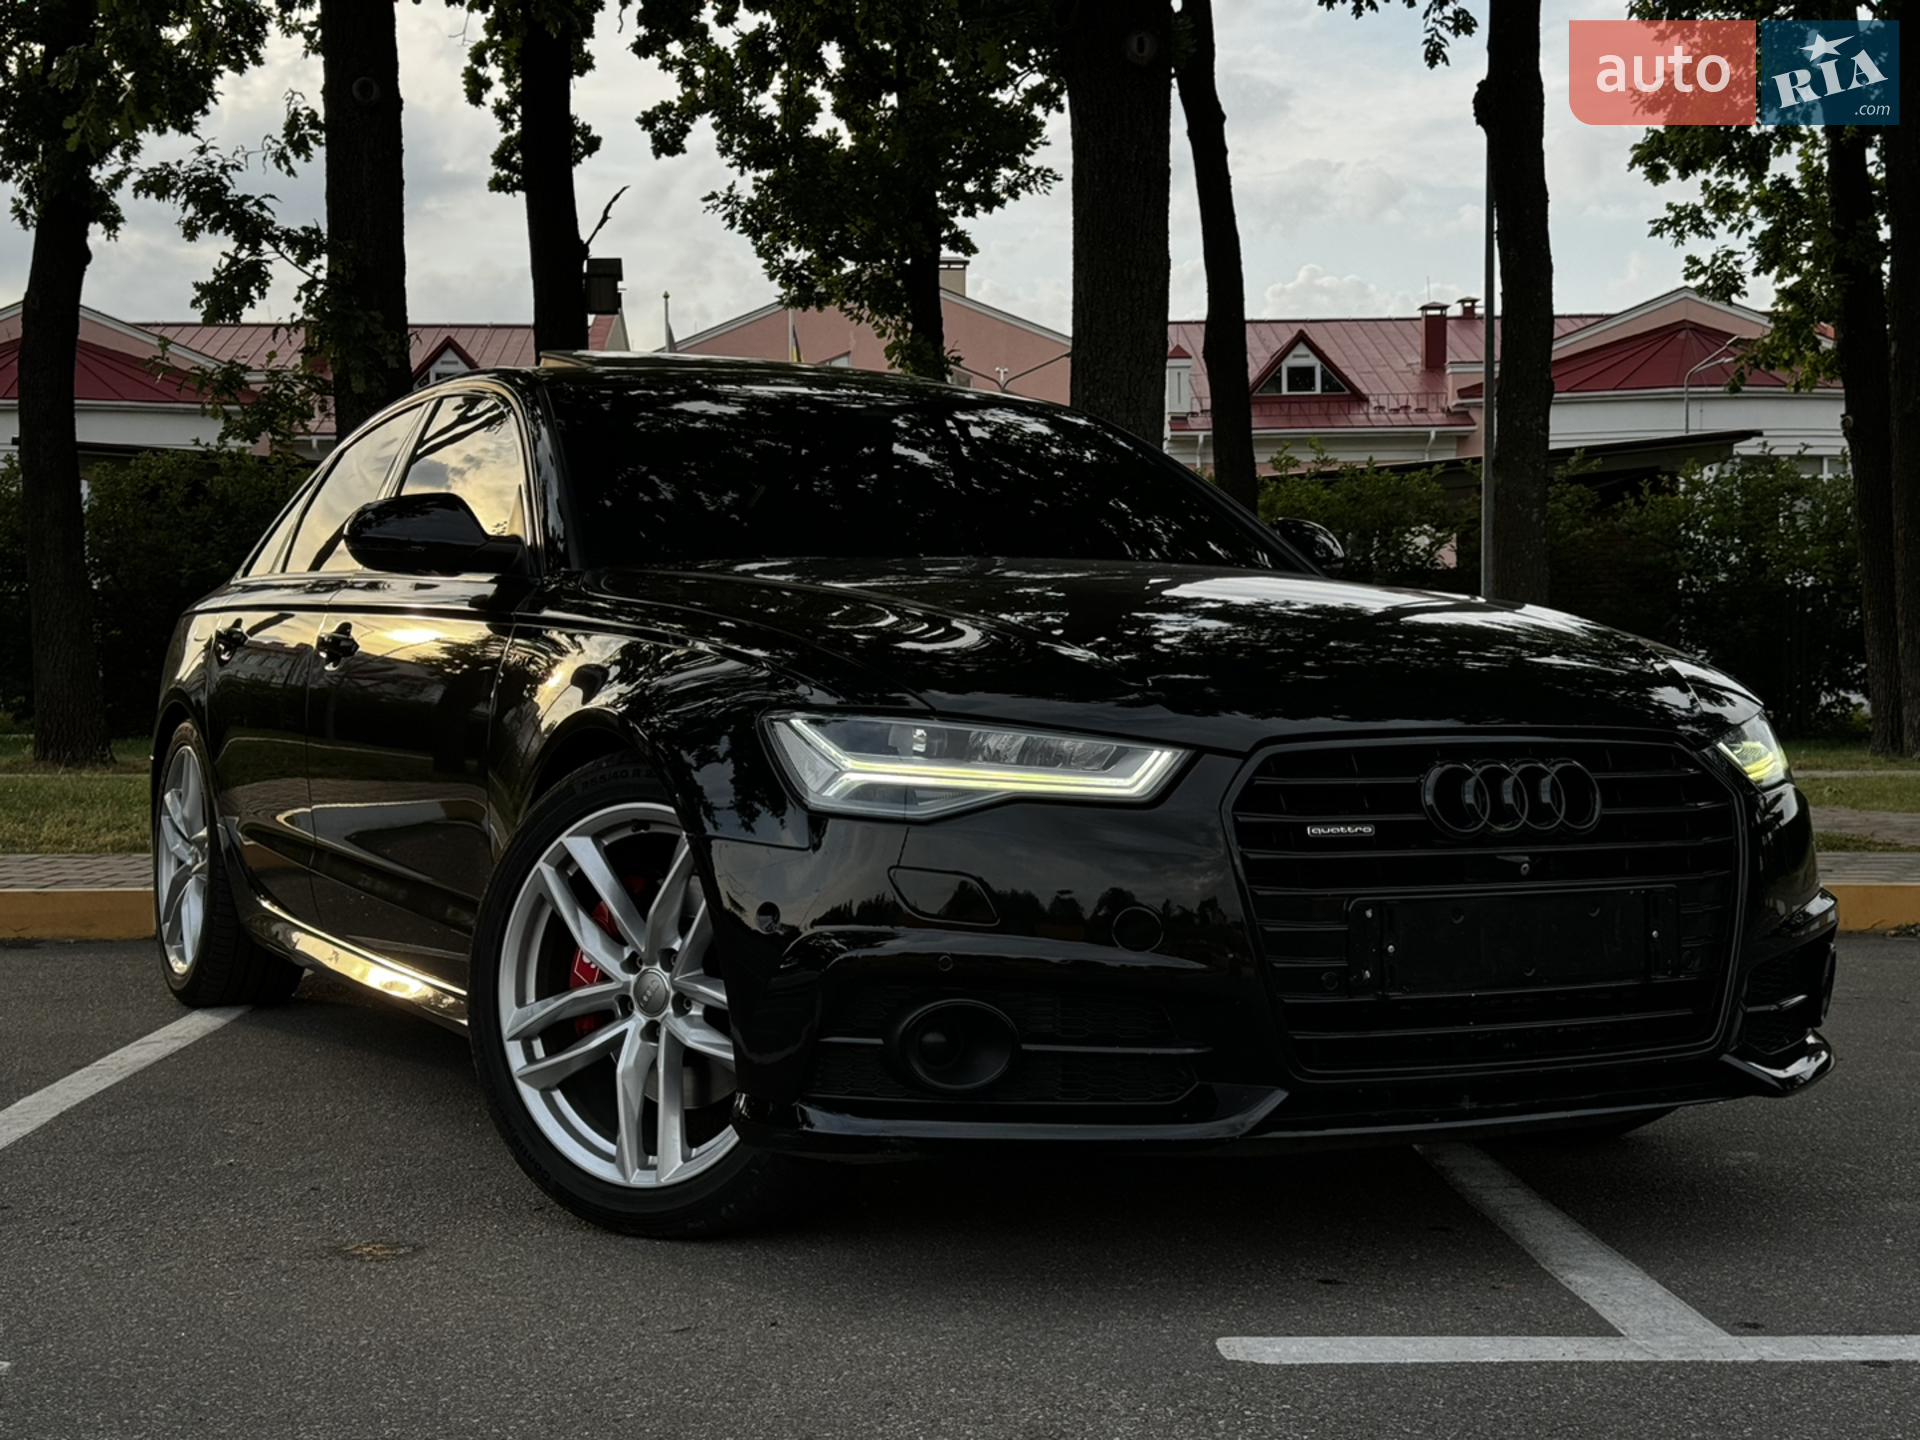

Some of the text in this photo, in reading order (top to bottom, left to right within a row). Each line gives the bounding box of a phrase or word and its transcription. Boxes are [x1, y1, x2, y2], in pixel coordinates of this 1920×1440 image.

[581, 770, 629, 789] 255/40
[644, 769, 657, 779] 2
[1311, 826, 1372, 836] quattro
